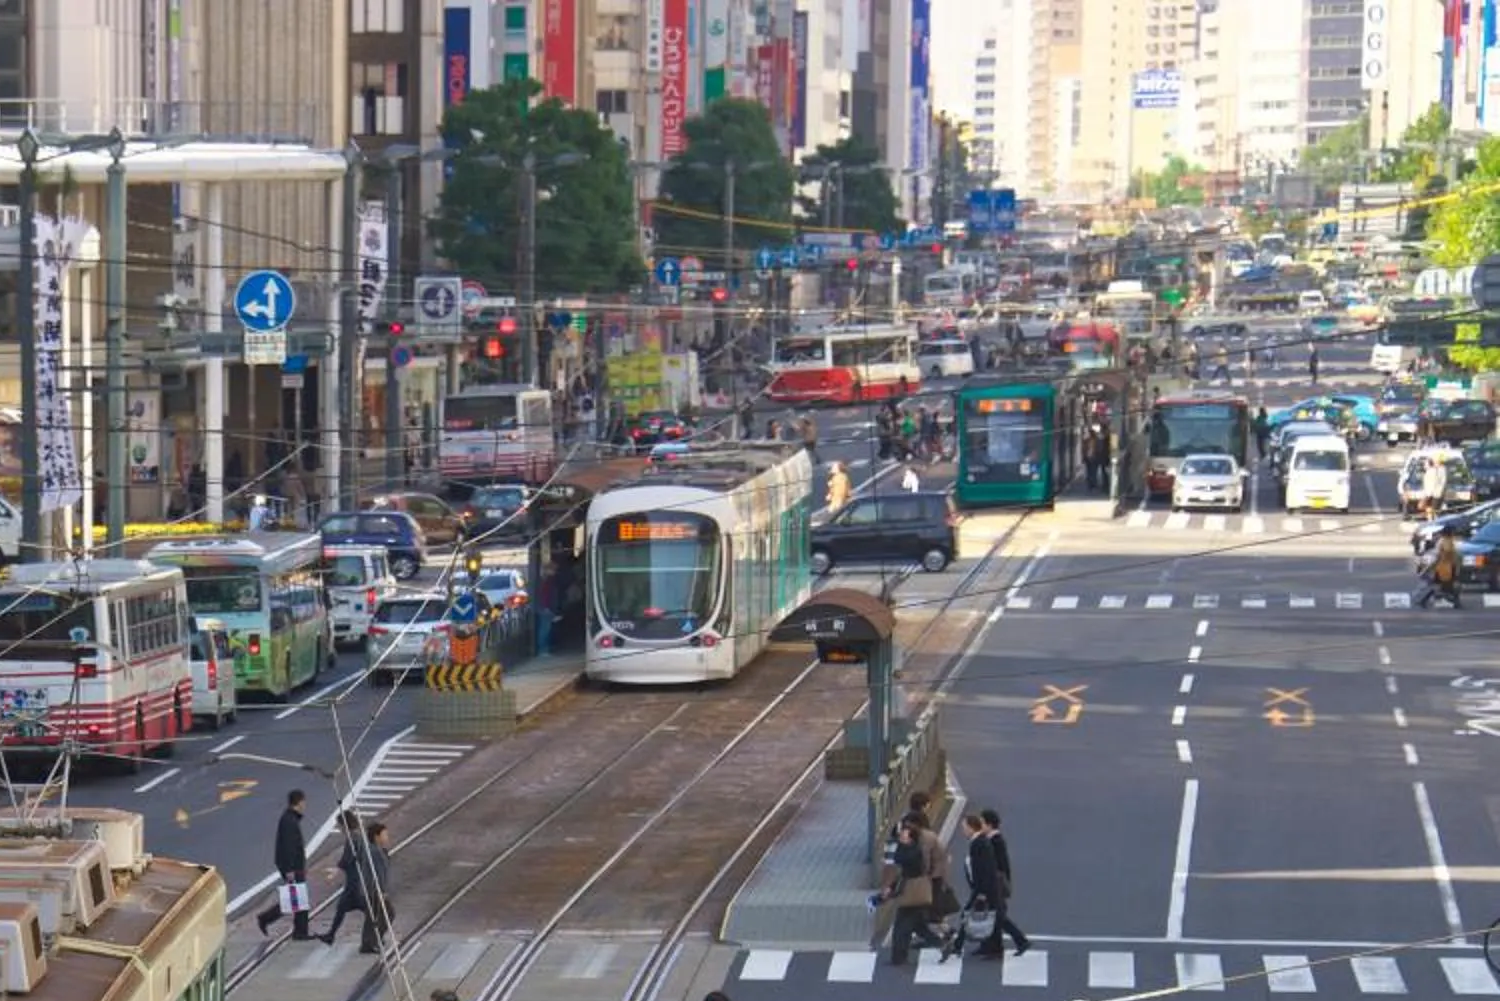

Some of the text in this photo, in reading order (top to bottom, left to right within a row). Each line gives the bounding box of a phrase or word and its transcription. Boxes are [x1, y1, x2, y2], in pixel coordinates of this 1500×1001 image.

[663, 27, 684, 162] ひろぎんウツミ
